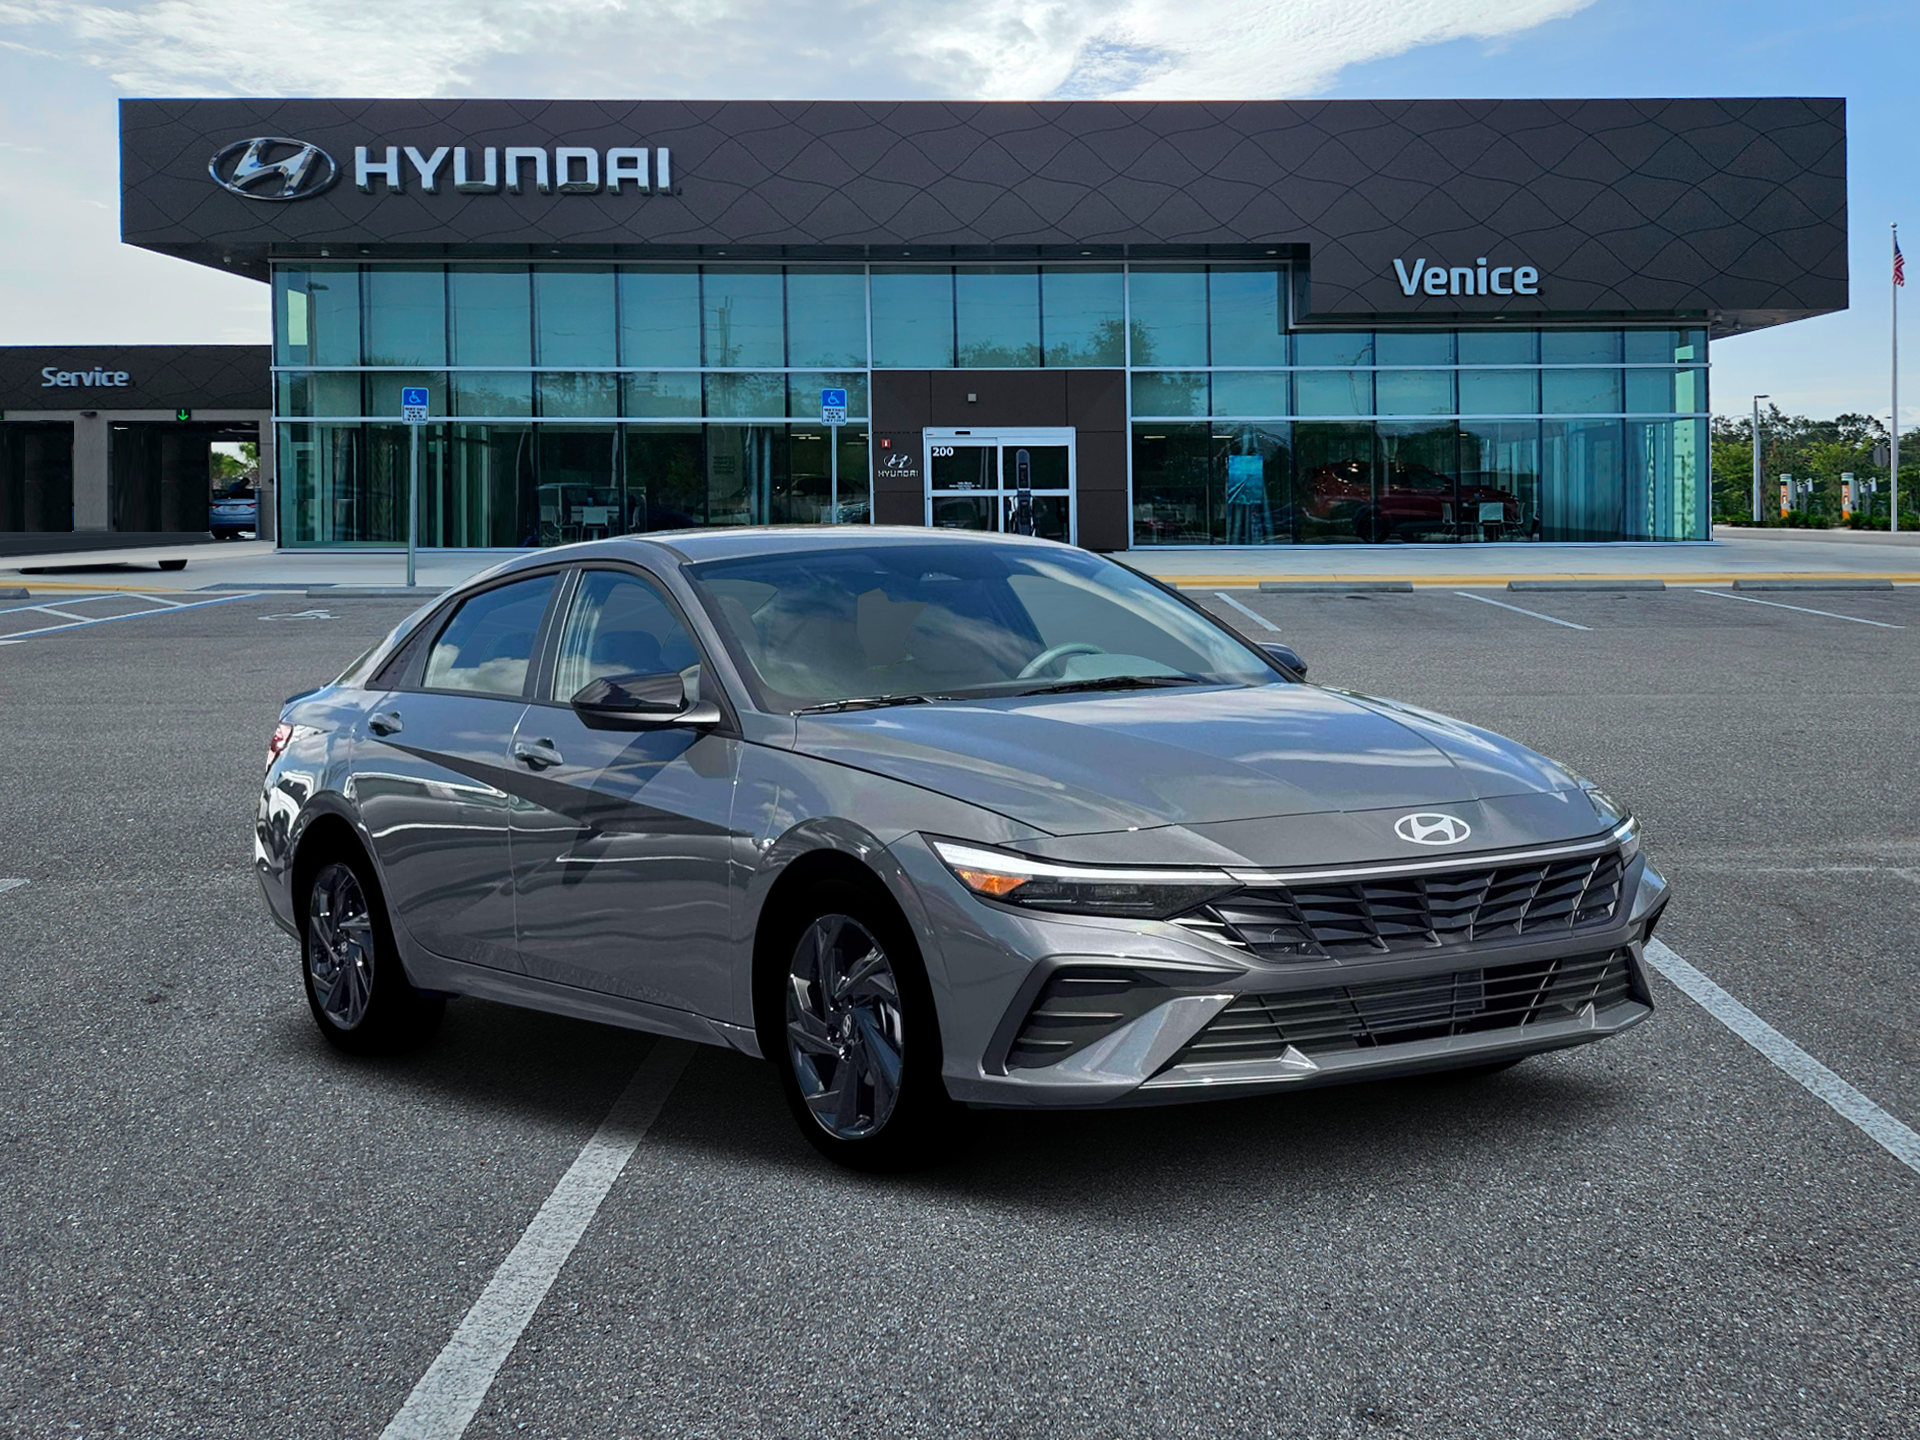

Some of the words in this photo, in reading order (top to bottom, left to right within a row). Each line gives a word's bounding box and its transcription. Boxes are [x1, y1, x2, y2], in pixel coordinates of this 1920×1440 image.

[354, 146, 672, 195] HYUNDAI
[1393, 257, 1538, 296] Venice
[41, 366, 130, 387] Service
[932, 446, 954, 457] 200
[877, 470, 919, 478] HYUNDAI
